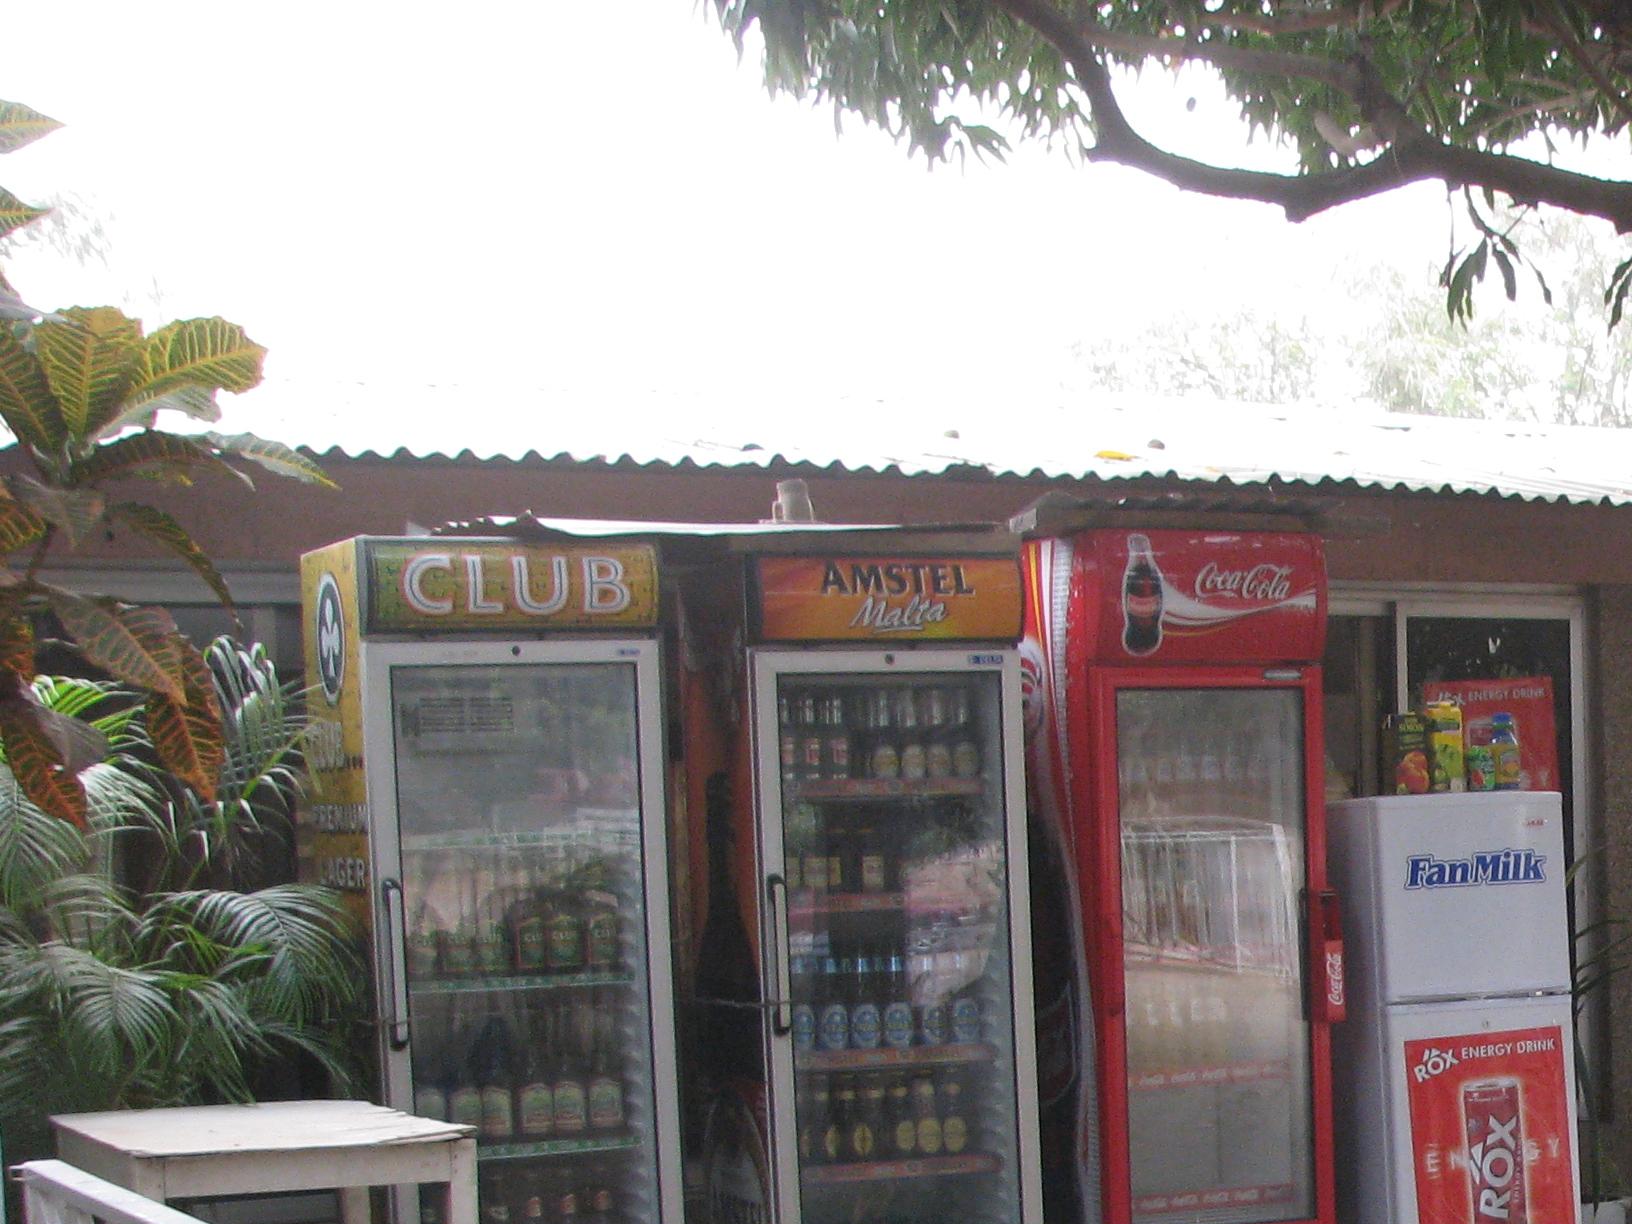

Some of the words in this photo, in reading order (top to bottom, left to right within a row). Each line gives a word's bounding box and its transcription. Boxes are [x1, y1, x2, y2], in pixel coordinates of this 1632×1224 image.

[402, 553, 632, 616] CLUB
[820, 559, 975, 597] AMSTEL
[1194, 561, 1294, 602] Coca-Cola
[849, 594, 947, 627] Malta
[1461, 1043, 1513, 1060] ENERGY
